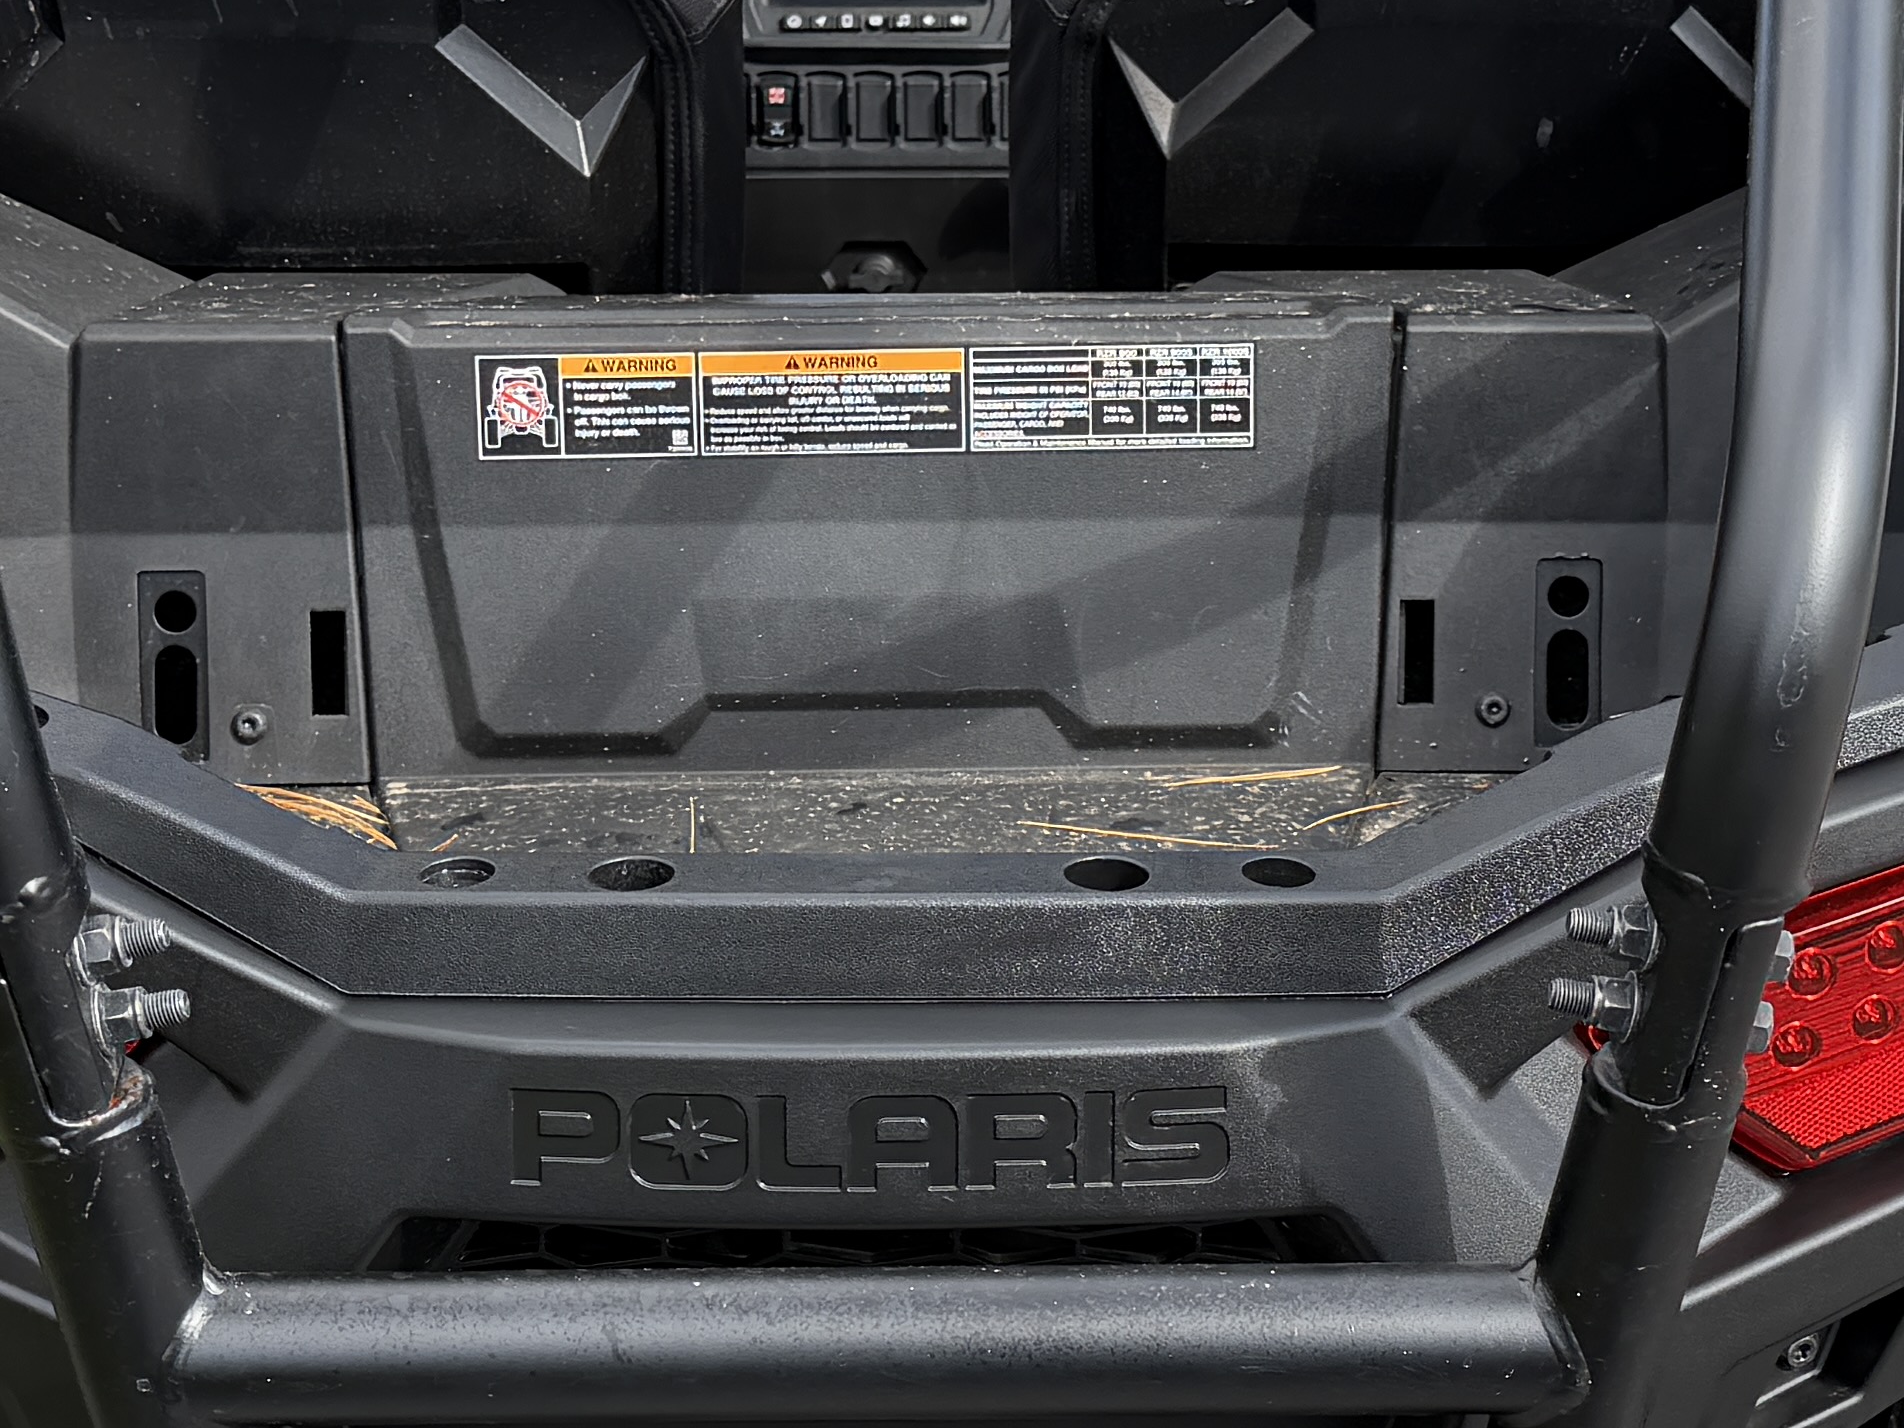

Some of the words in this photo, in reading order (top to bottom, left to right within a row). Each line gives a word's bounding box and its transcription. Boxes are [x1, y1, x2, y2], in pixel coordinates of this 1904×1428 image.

[600, 358, 677, 372] WARNING
[802, 355, 878, 370] WARNING
[510, 1086, 1232, 1192] POLARIS
